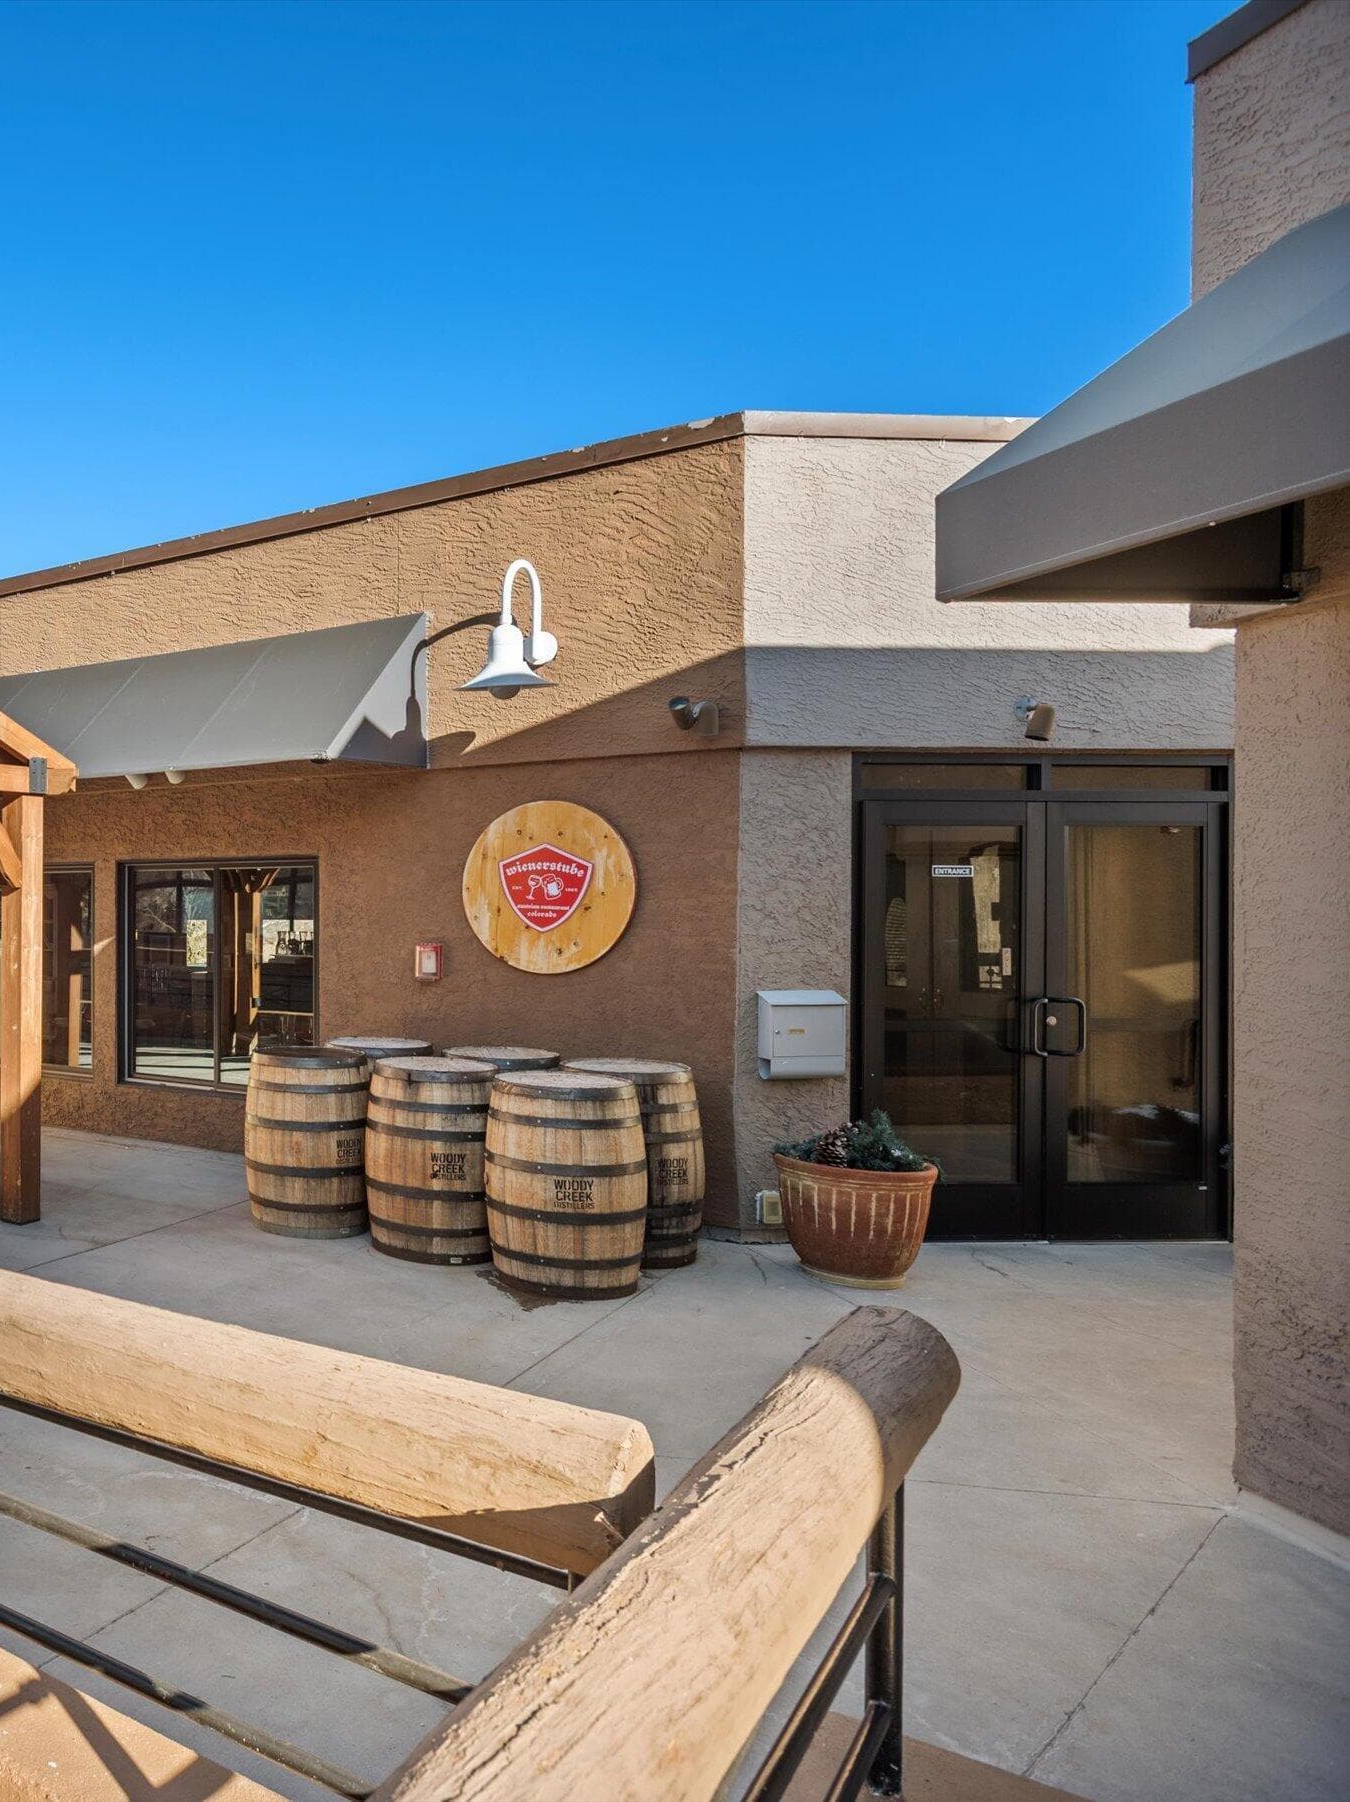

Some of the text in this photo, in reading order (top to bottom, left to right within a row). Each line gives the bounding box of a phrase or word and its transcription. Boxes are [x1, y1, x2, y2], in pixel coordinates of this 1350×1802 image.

[505, 861, 585, 877] wienerstube
[527, 910, 557, 918] colorado
[431, 1152, 466, 1163] WOODY
[657, 1157, 688, 1168] WOODY
[432, 1163, 465, 1174] CREEK
[659, 1168, 687, 1178] CREEK
[554, 1179, 594, 1190] WOODY
[556, 1190, 593, 1201] CREEK
[553, 1201, 595, 1210] DISTILLERS
